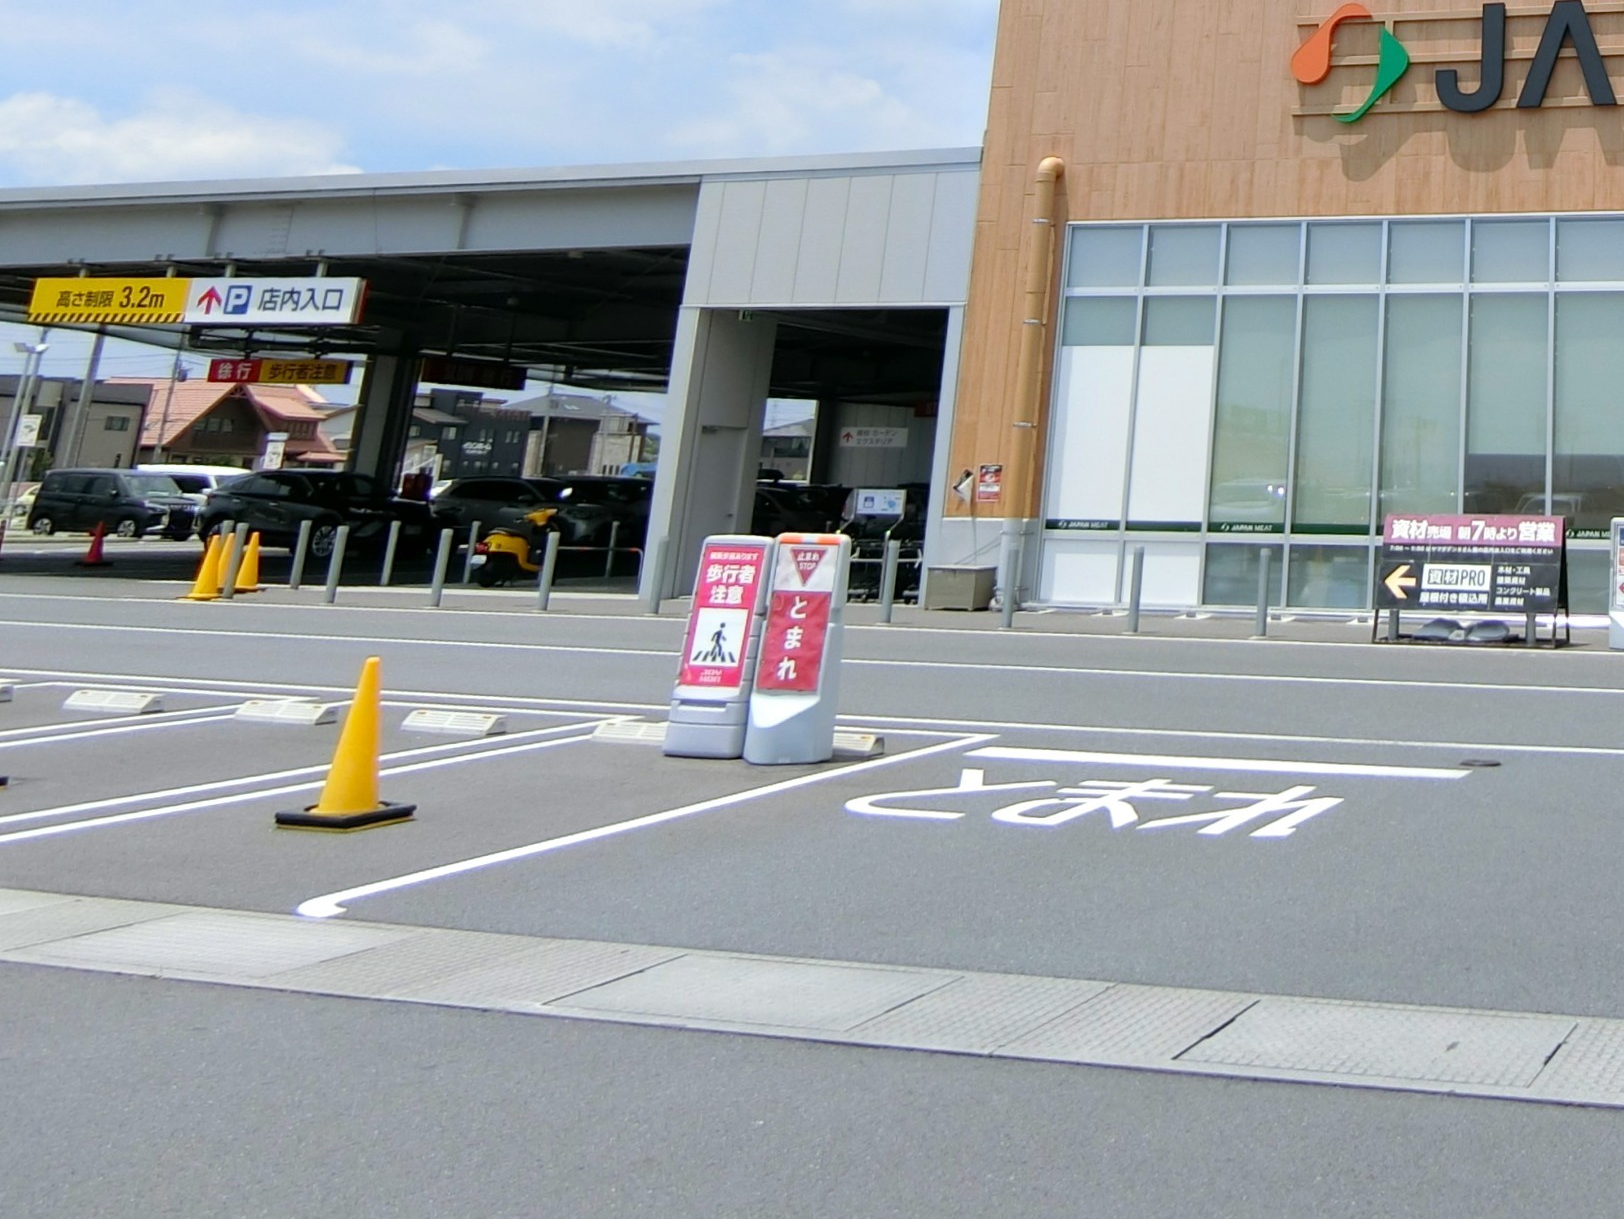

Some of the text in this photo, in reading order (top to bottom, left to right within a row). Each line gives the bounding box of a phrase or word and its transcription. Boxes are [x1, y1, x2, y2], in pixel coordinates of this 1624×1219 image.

[56, 286, 165, 309] 高さ制限 3.2m
[258, 287, 343, 312] 店内入口
[217, 362, 252, 380] 徐行
[268, 363, 337, 380] 歩行者注意
[1458, 520, 1555, 543] 朝7時より営業
[706, 564, 757, 584] 歩行者
[799, 562, 817, 571] STOP
[709, 585, 744, 605] 注意
[776, 595, 808, 681] とまれ
[844, 768, 1345, 838] とまれ
